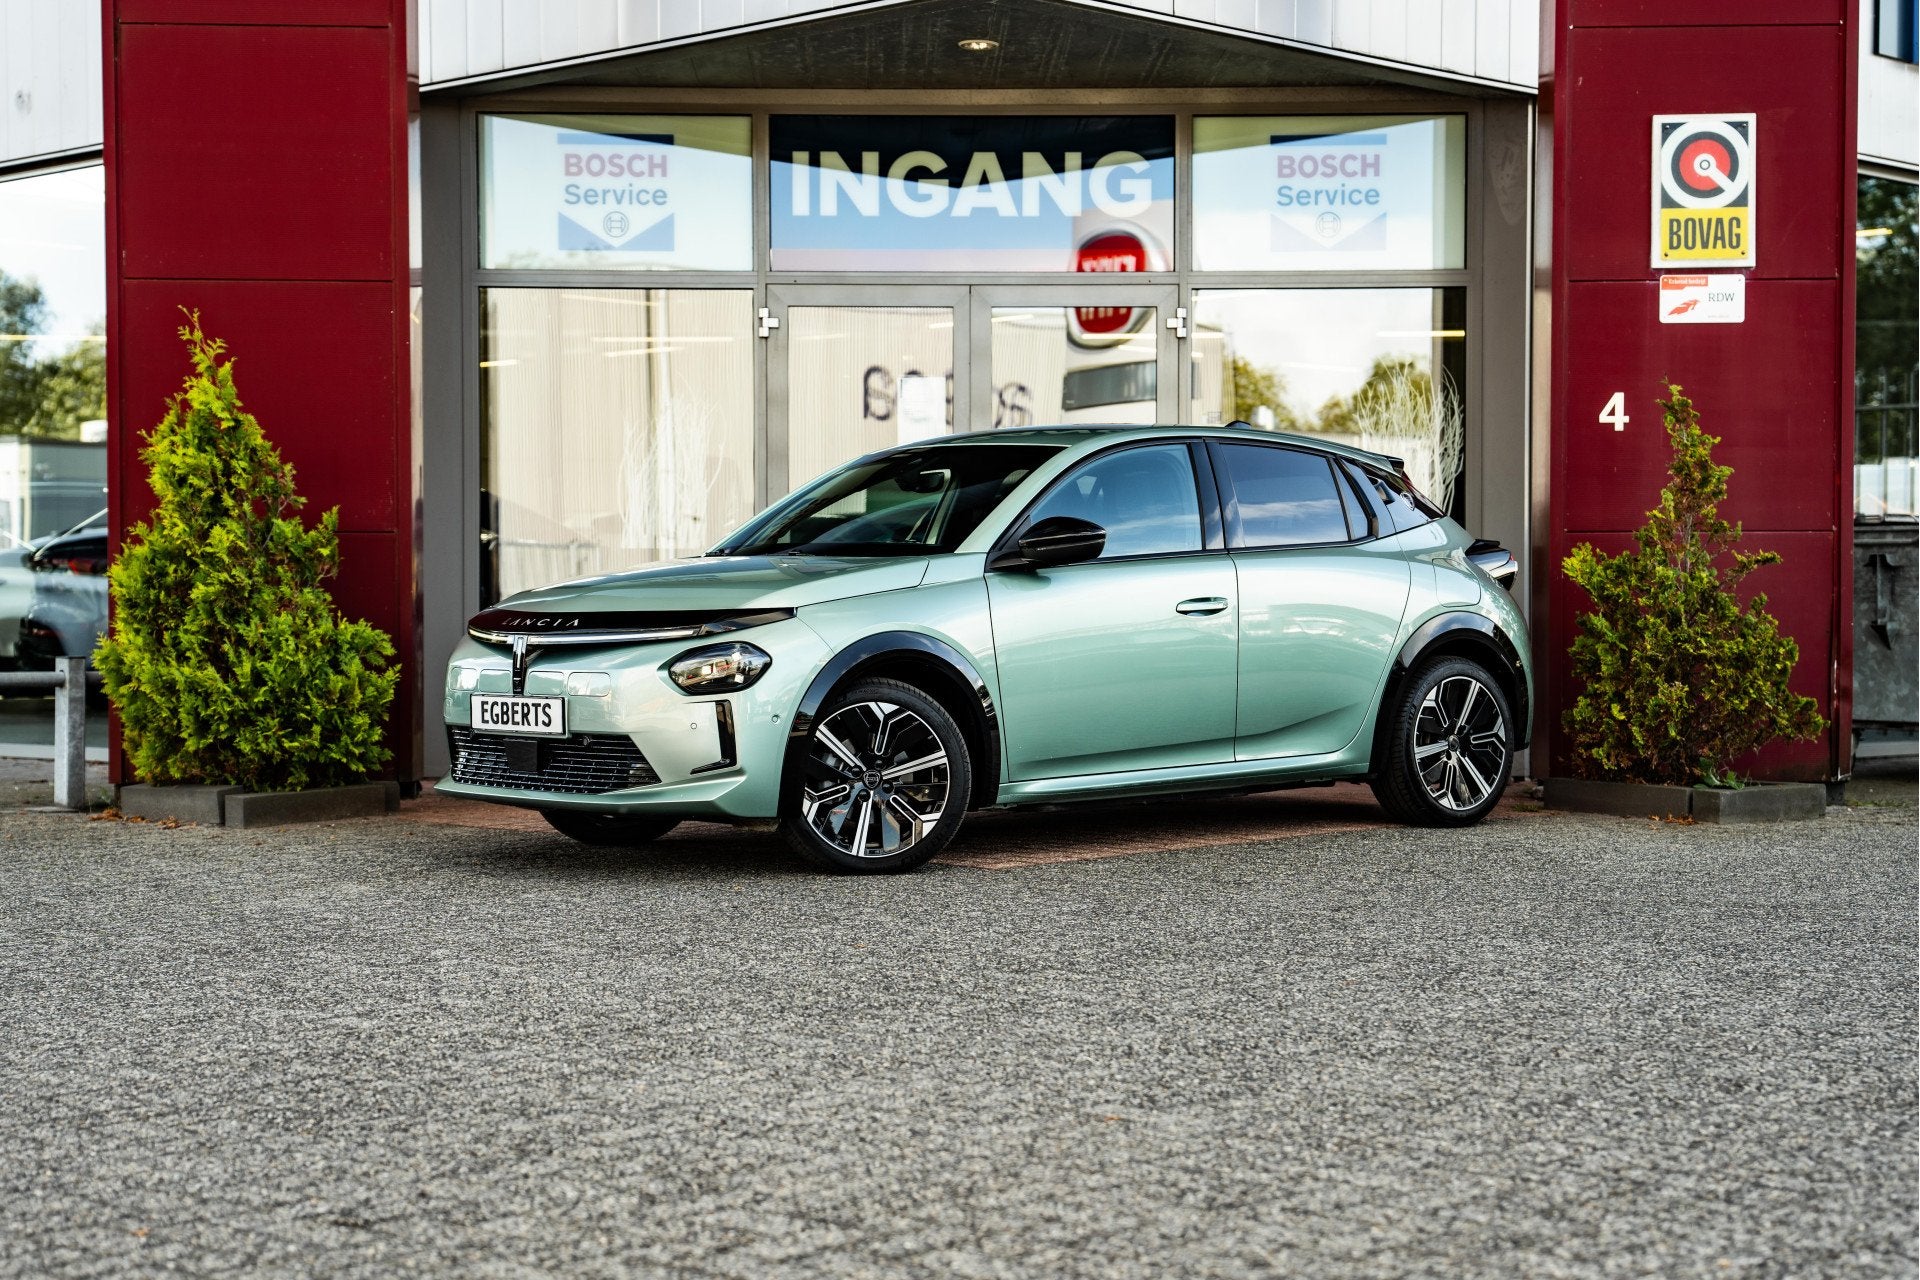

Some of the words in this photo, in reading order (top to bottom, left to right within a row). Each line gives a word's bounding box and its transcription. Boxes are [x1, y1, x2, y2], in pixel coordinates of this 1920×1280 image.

[564, 153, 668, 178] BOSCH
[1277, 153, 1381, 179] BOSCH
[564, 183, 668, 206] Service
[792, 150, 1153, 218] INGANG
[1276, 183, 1380, 206] Service
[1669, 217, 1741, 250] BOVAG
[1708, 292, 1735, 302] RDW
[1599, 392, 1629, 431] 4
[502, 618, 579, 626] LANCIA
[481, 700, 552, 728] EGBERTS
